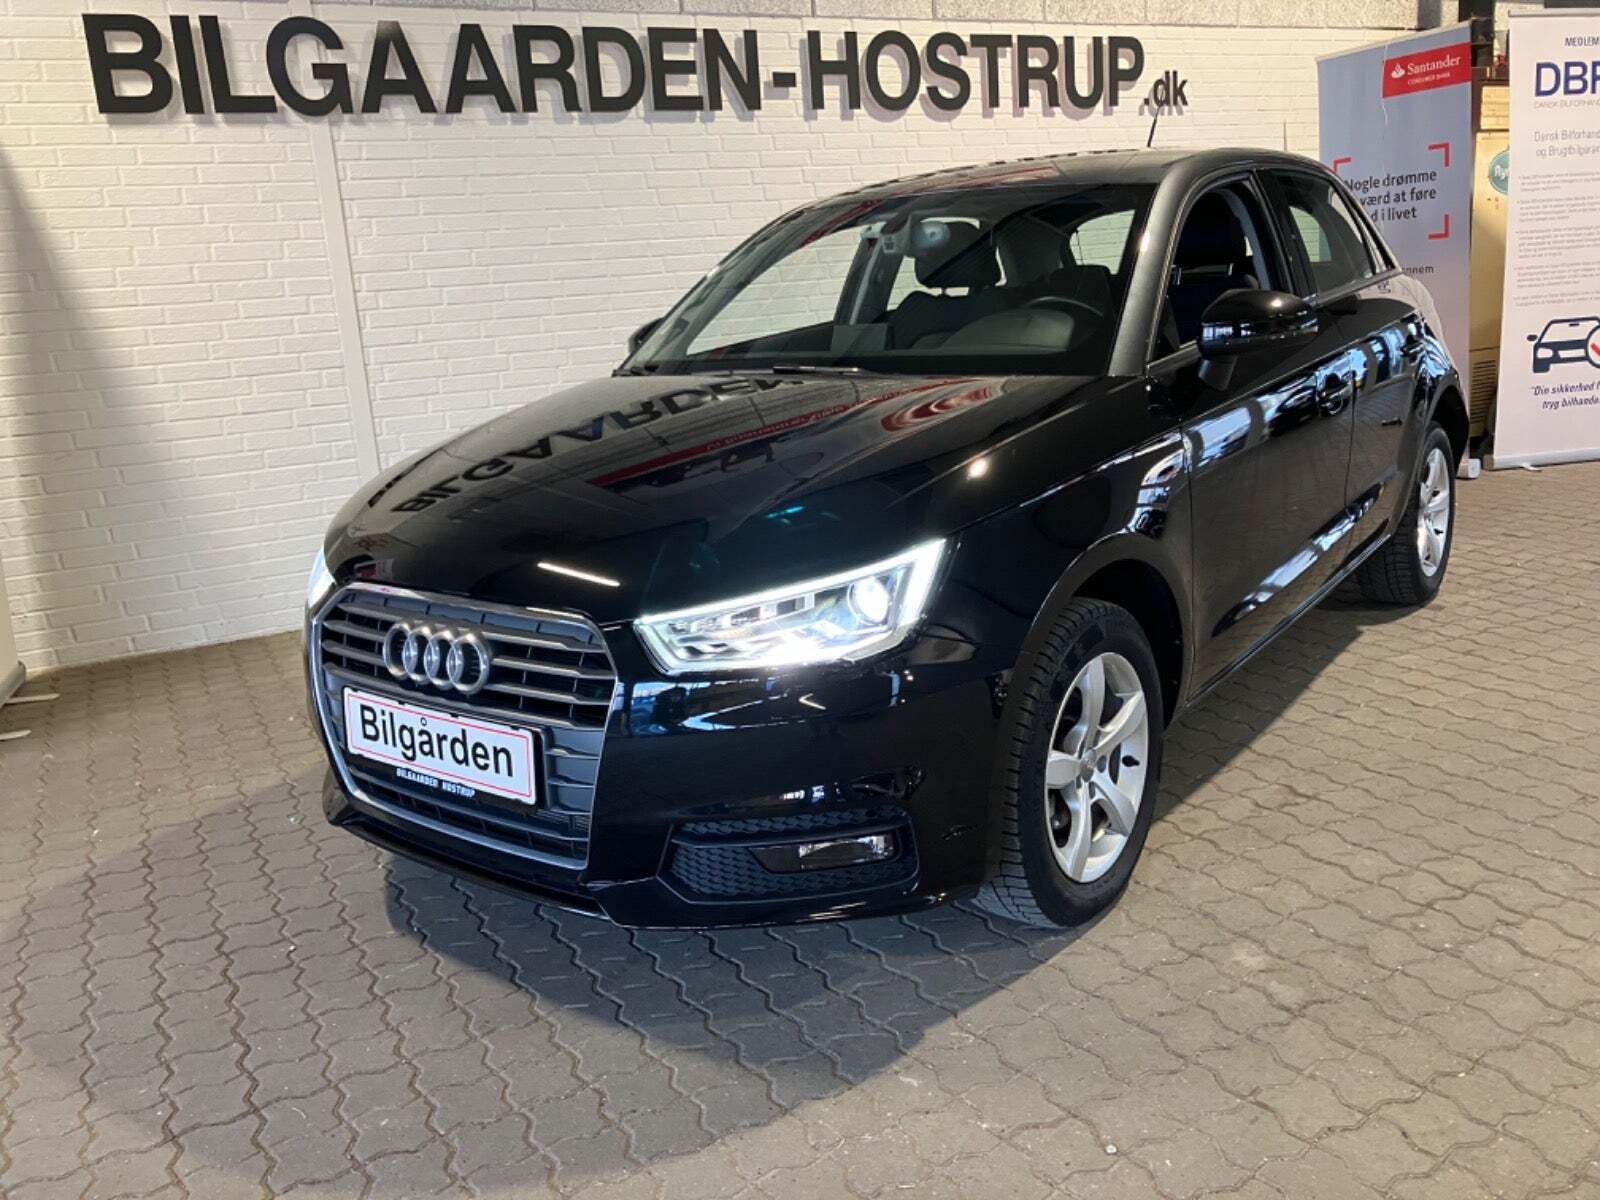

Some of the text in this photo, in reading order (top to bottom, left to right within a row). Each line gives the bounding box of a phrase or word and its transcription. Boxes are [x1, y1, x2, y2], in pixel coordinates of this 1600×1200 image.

[1407, 54, 1461, 76] Santander
[1344, 171, 1437, 194] Nogle drømme
[1393, 191, 1407, 202] at
[1410, 187, 1437, 202] føre
[1387, 207, 1417, 221] livet
[360, 703, 514, 778] Bilgården
